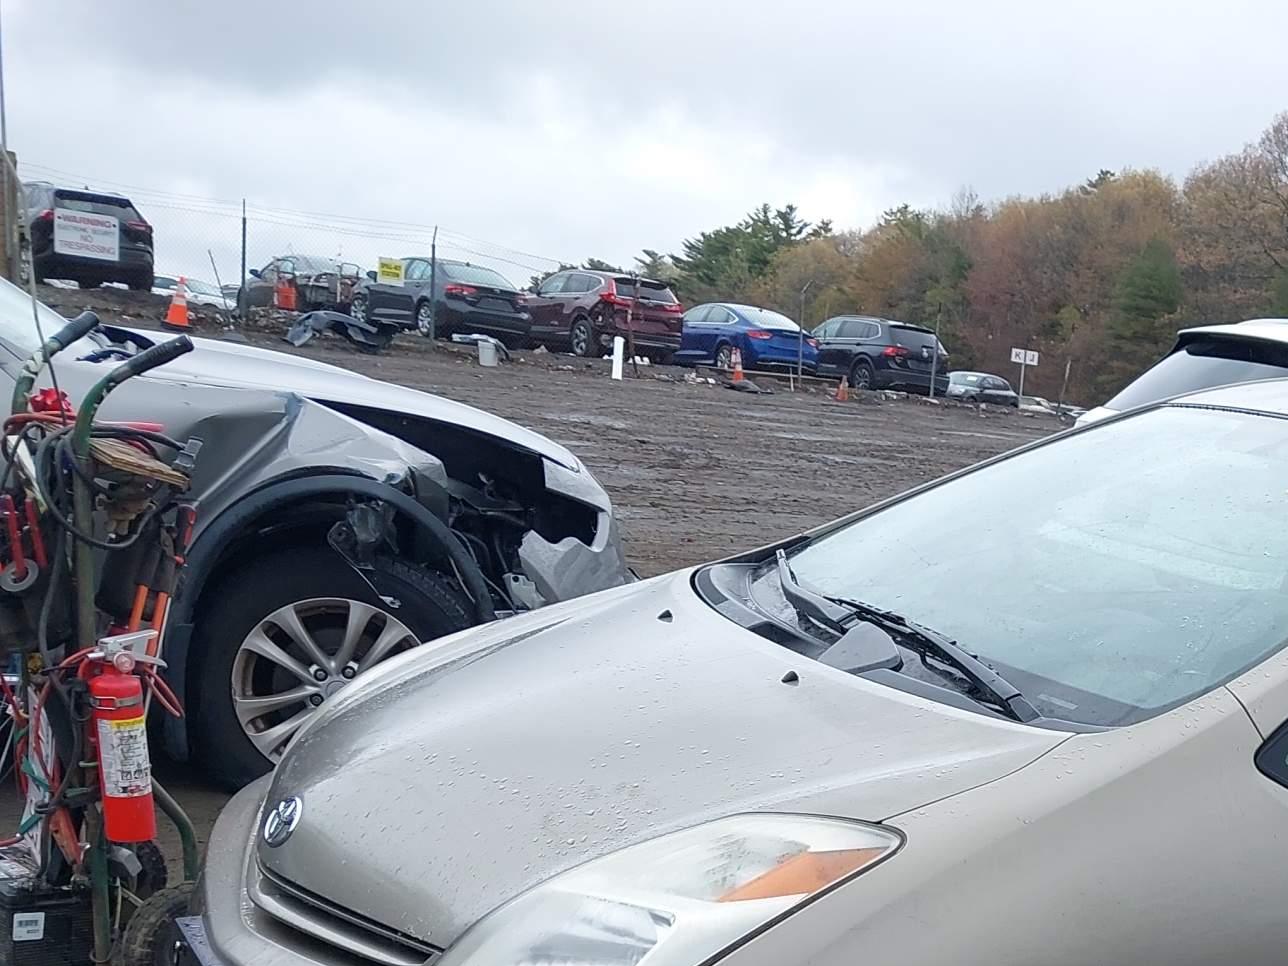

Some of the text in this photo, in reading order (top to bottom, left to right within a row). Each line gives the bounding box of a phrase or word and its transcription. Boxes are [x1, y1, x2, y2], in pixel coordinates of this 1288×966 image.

[62, 214, 112, 229] WARNING
[80, 234, 94, 243] NO
[59, 240, 116, 256] TRESPASSING
